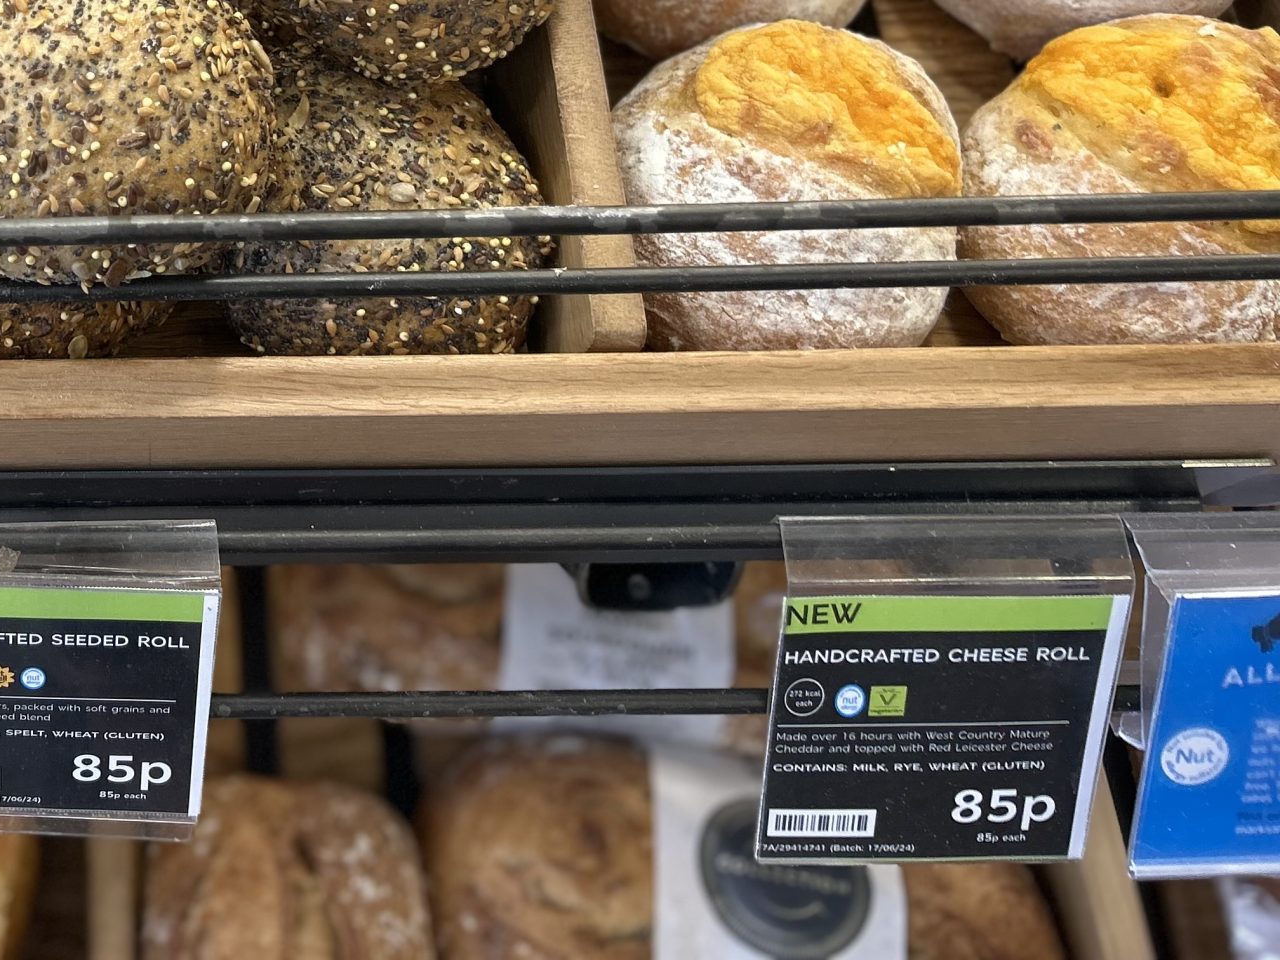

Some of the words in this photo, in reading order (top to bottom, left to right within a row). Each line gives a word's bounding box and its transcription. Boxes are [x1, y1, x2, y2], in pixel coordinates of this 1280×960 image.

[786, 602, 862, 625] NEW
[51, 634, 129, 647] SEEDED
[137, 636, 190, 649] ROLL
[784, 647, 940, 665] HANDCRAFTED
[948, 647, 1028, 663] CHEESE
[1036, 646, 1090, 662] ROLL
[13, 702, 54, 712] packed
[57, 704, 81, 712] with
[85, 704, 107, 712] soft
[111, 706, 145, 714] grains
[149, 706, 171, 714] and
[795, 700, 813, 708] each
[19, 713, 51, 721] blend
[5, 729, 48, 738] SPELT,
[52, 730, 100, 738] WHEAT
[104, 731, 165, 741] (GLUTEN)
[776, 732, 807, 741] Made
[811, 733, 837, 741] over
[843, 732, 856, 740] 16
[860, 732, 893, 740] hours
[897, 731, 921, 740] with
[926, 731, 954, 740] West
[958, 730, 1006, 741] Country
[1010, 730, 1050, 739] Mature
[775, 744, 824, 753] Cheddar
[828, 744, 850, 753] and
[854, 744, 896, 754] topped
[900, 743, 924, 752] with
[928, 743, 951, 752] Red
[955, 743, 1007, 752] Leicester
[1011, 742, 1053, 751] Cheese
[1176, 748, 1214, 764] Nut
[773, 763, 848, 772] CONTAINS:
[852, 763, 888, 772] MILK,
[894, 763, 923, 772] RYE,
[928, 762, 978, 771] WHEAT
[982, 761, 1045, 771] (GLUTEN)
[72, 754, 172, 792] 85p
[99, 790, 121, 800] 85p
[124, 792, 147, 800] each
[951, 789, 1056, 831] 85p
[976, 833, 998, 843] 85p
[1002, 833, 1026, 841] each
[761, 843, 826, 852] 7A/29414741
[830, 844, 865, 853] (Batch:
